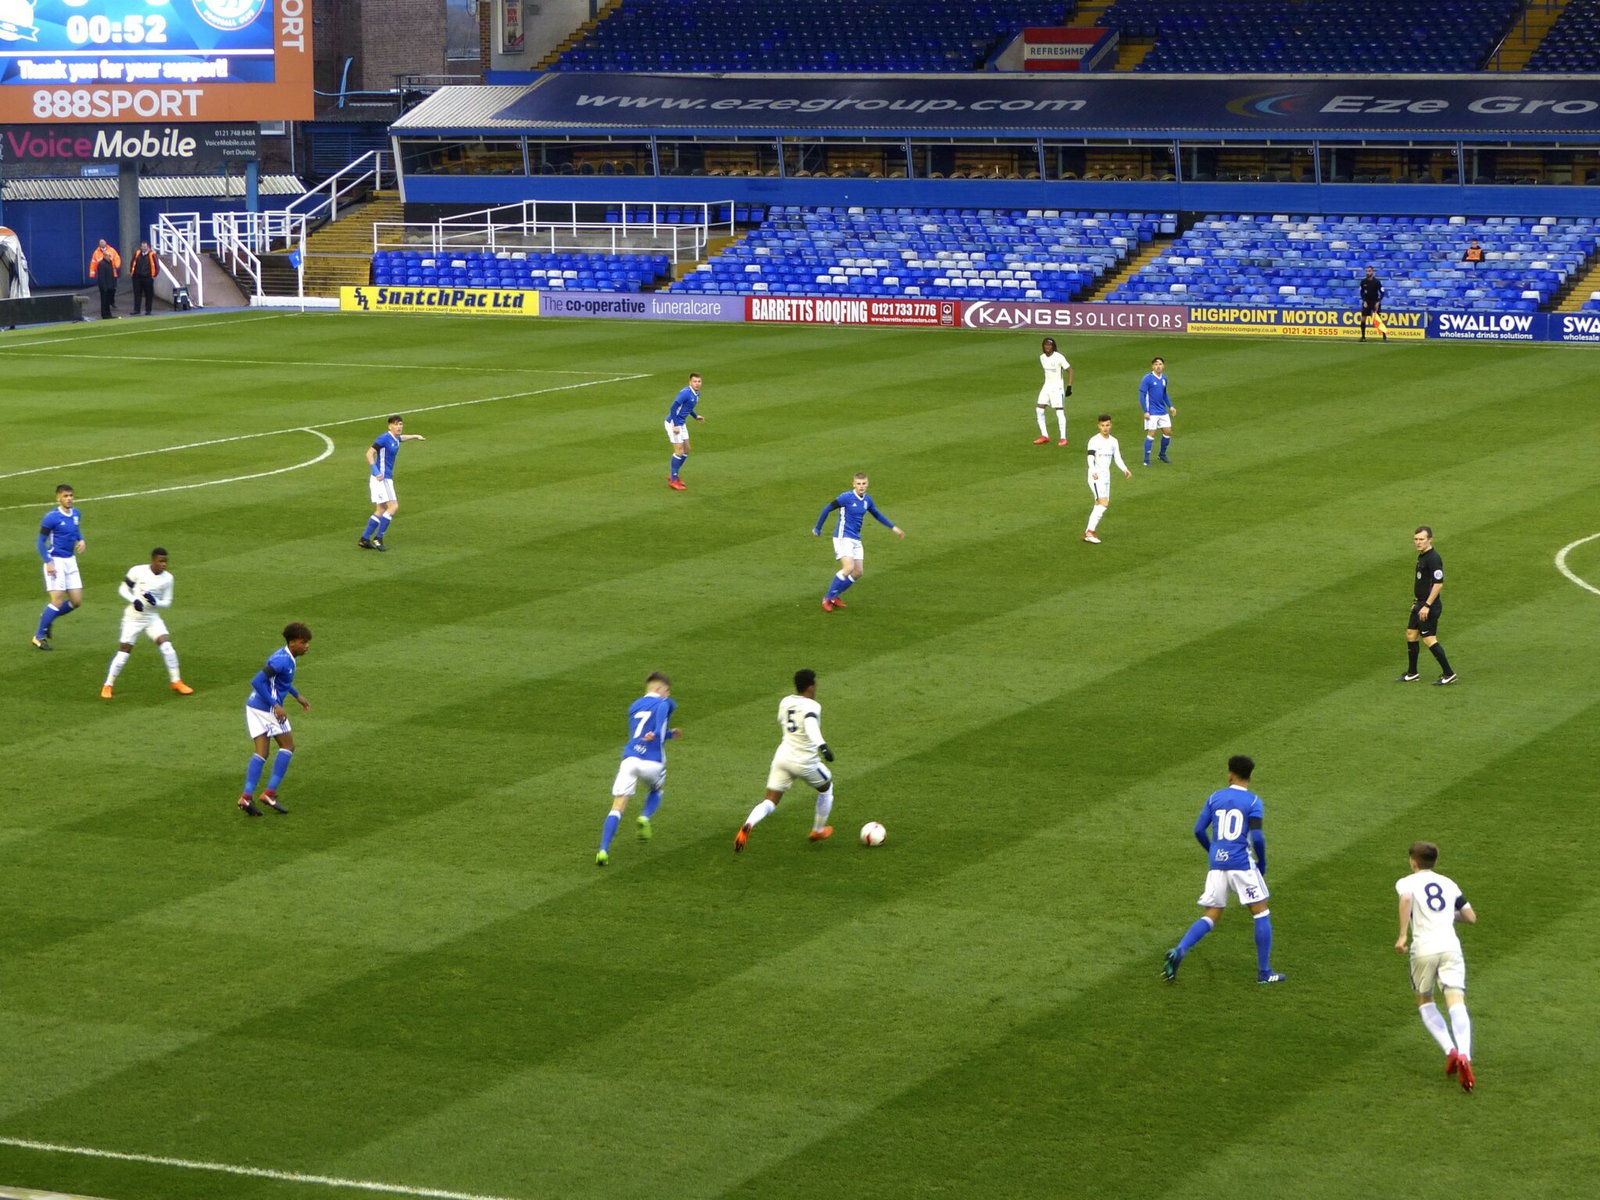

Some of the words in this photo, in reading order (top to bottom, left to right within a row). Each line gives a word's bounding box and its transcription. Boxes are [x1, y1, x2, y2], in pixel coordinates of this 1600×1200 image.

[66, 15, 168, 44] 00:52
[68, 61, 98, 83] you
[99, 58, 124, 79] for
[125, 61, 162, 83] your
[33, 89, 204, 118] 888SPORT
[575, 94, 1087, 113] www.ezegroup.com
[1319, 95, 1450, 114] Eze
[1467, 95, 1599, 114] Gro
[235, 149, 257, 157] Dunlop
[376, 288, 488, 308] SnatchPac
[492, 292, 525, 308] Ltd
[542, 295, 563, 312] The
[652, 298, 721, 316] funeralcare
[752, 298, 813, 322] BARRETTS
[815, 300, 868, 323] ROOFING
[871, 302, 894, 316] 0121
[895, 303, 913, 316] 733
[914, 303, 937, 317] 7776
[979, 307, 1071, 326] KANGS
[1075, 312, 1183, 328] SOLICITORS
[1190, 308, 1278, 323] HIGHPOINT
[1282, 310, 1339, 325] MOTOR
[1190, 325, 1277, 334] highpointmotorcompany.co.uk
[1282, 327, 1300, 335] 0121
[1302, 327, 1316, 335] 421
[1318, 328, 1339, 336] 5555
[1439, 314, 1533, 331] SWALLOW
[1439, 331, 1475, 339] wholesale
[1476, 331, 1499, 339] drinks
[1500, 331, 1533, 340] solutions
[632, 710, 653, 739] 7
[787, 709, 798, 733] 5
[1215, 808, 1244, 841] 10
[1424, 882, 1446, 912] 8
